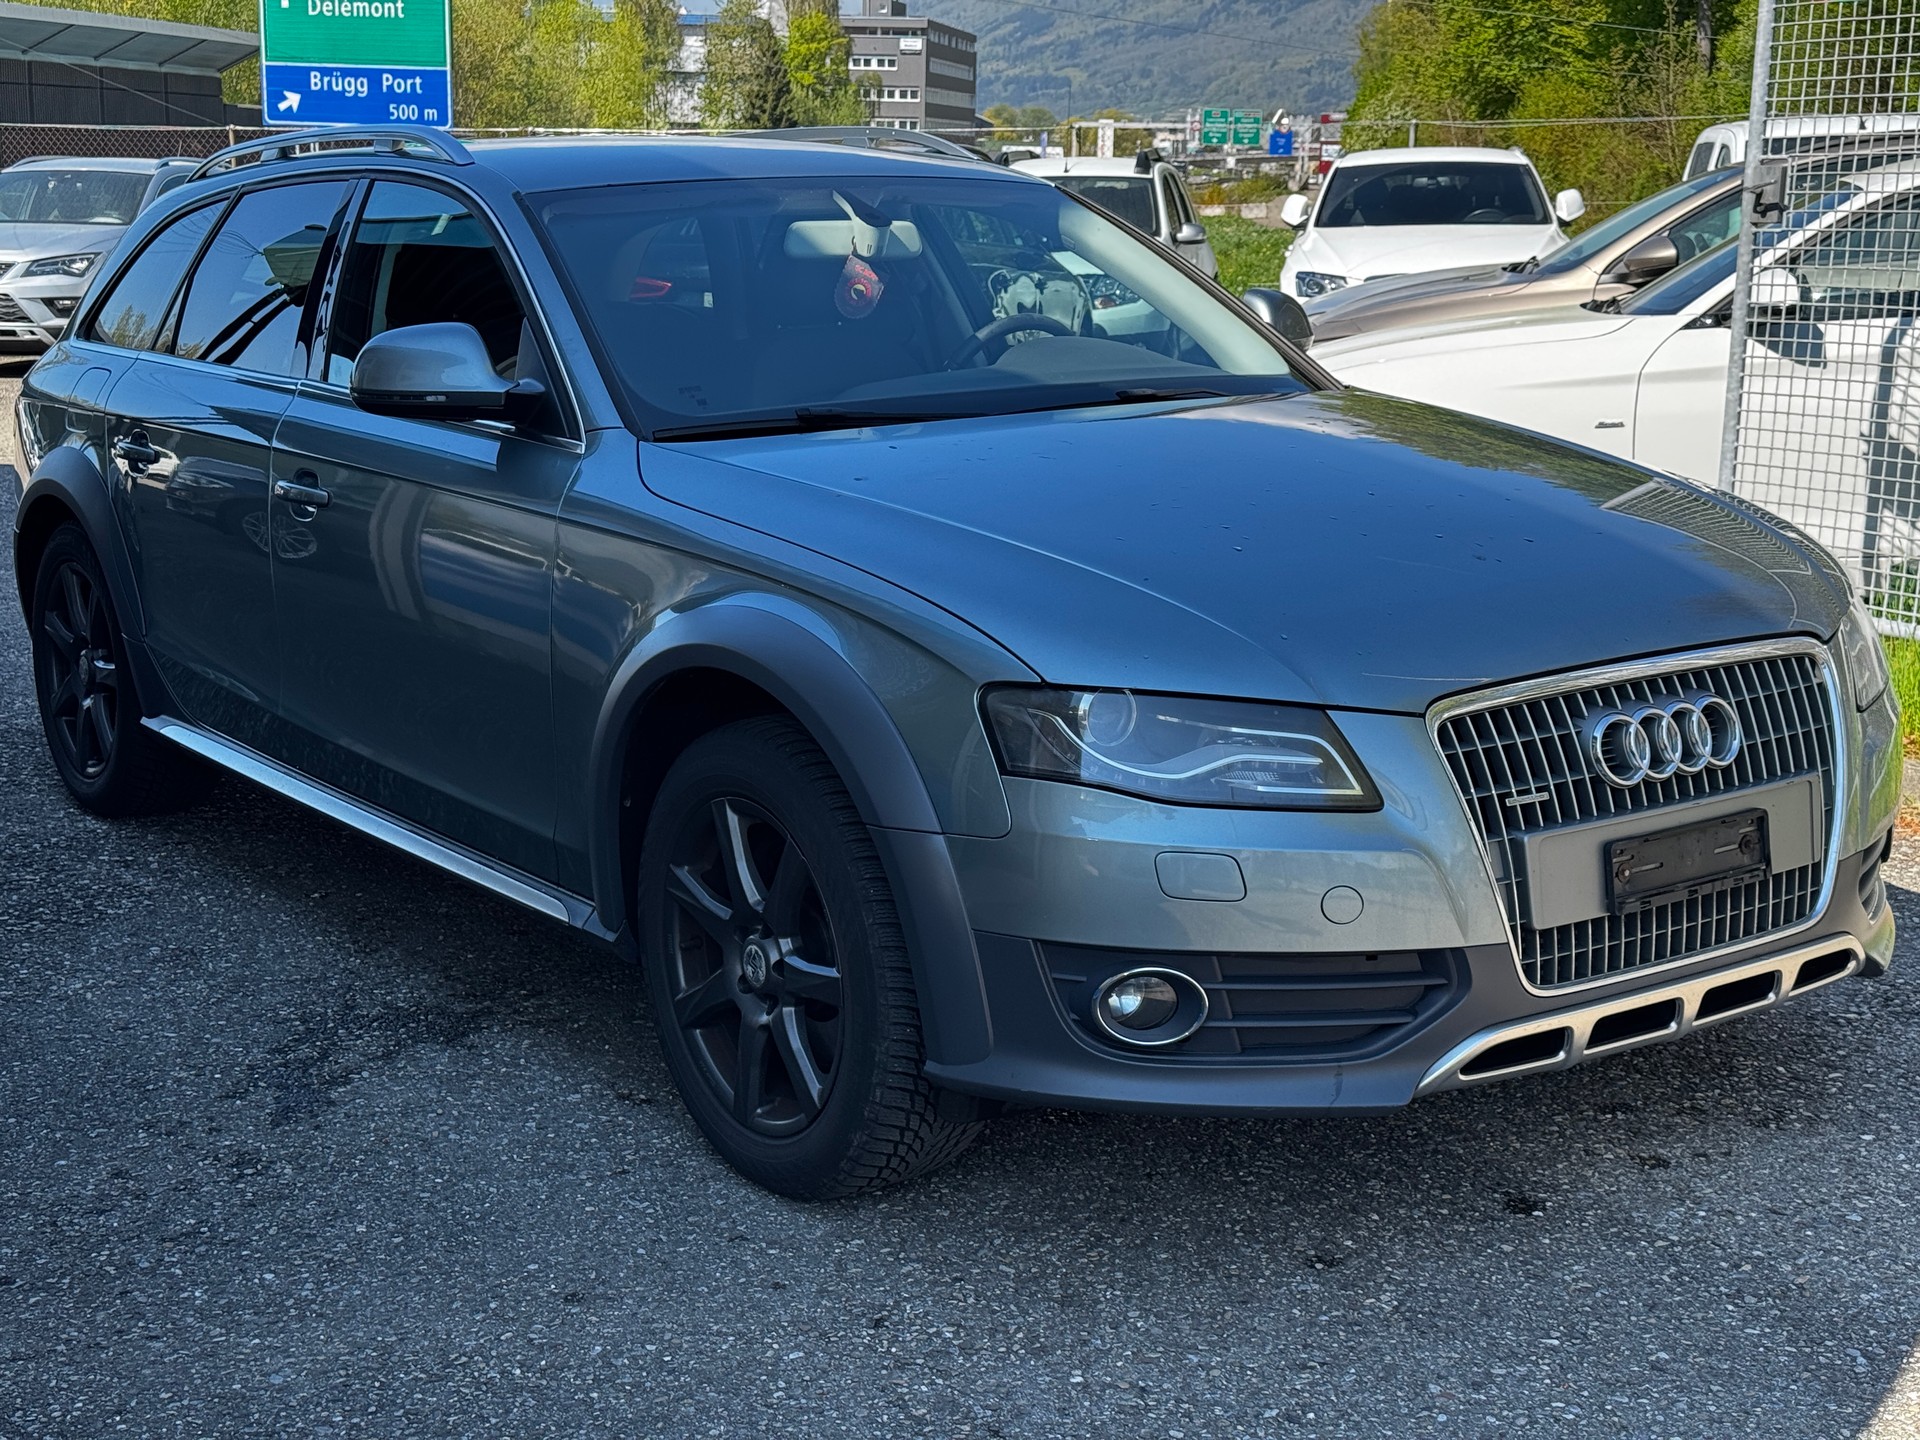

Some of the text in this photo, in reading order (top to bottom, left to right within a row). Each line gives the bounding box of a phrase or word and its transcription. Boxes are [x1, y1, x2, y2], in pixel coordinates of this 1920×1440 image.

[310, 71, 422, 97] Brügg Port
[389, 104, 437, 121] 500 m
